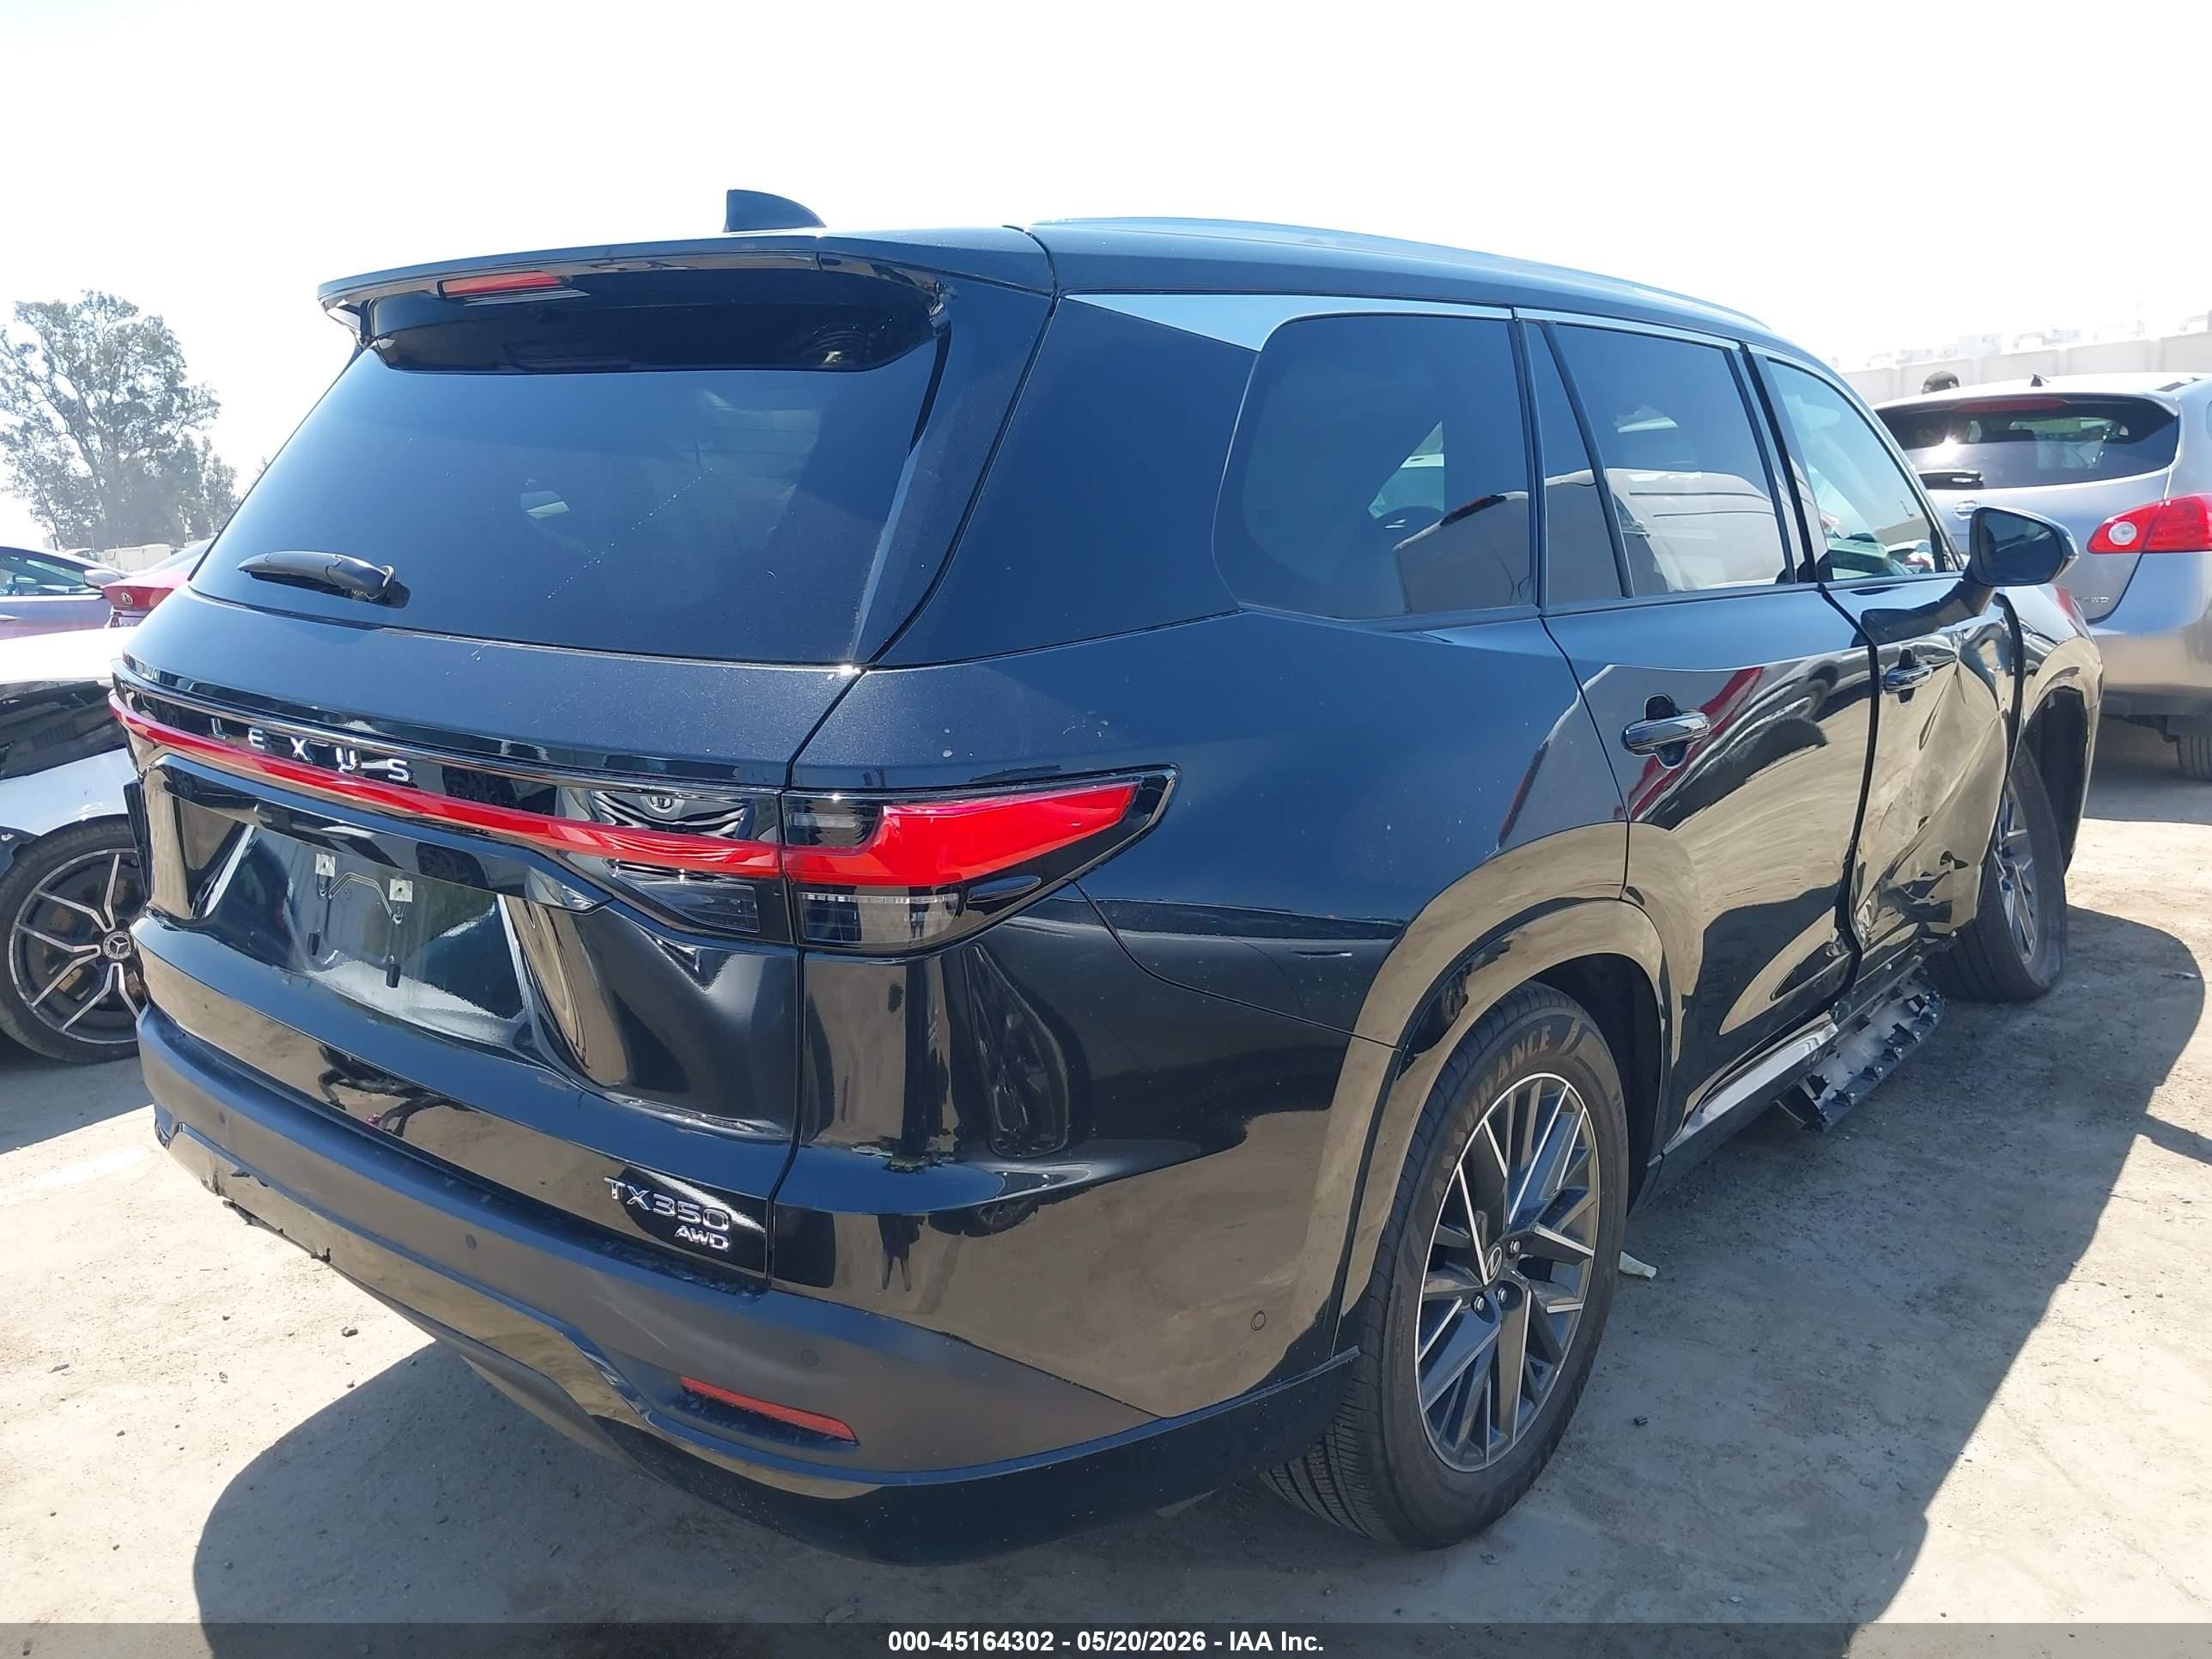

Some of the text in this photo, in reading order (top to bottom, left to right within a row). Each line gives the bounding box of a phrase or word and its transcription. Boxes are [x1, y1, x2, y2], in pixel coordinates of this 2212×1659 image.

[210, 718, 412, 782] LEXUS
[604, 1176, 729, 1232] TX350
[674, 1224, 729, 1252] AWD
